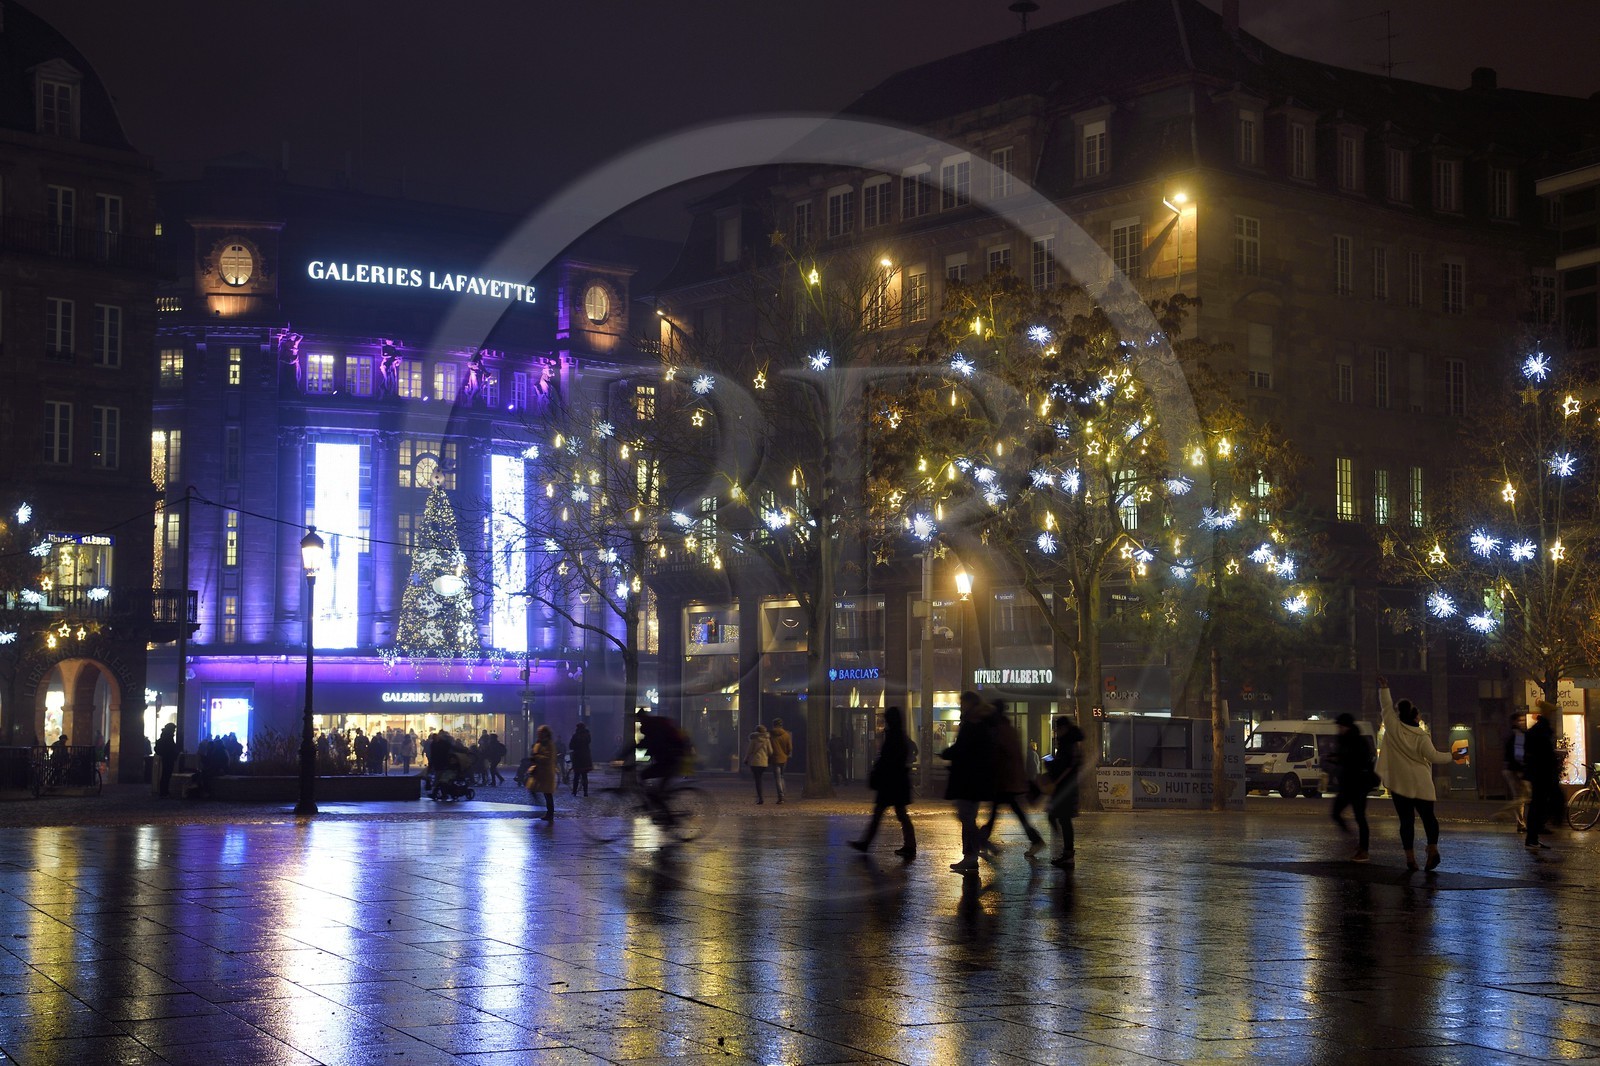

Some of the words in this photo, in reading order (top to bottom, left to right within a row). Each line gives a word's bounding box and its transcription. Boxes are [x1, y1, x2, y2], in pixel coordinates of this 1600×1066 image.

[308, 261, 423, 287] GALERIES
[430, 271, 536, 304] LAFAYETTE
[838, 668, 879, 680] BARCLAYS
[1002, 668, 1053, 684] D'ALBERTO
[382, 692, 431, 703] GALERIES
[432, 692, 484, 703] LAFAYETTE
[1562, 699, 1579, 708] petits
[1165, 782, 1214, 793] HUITRES
